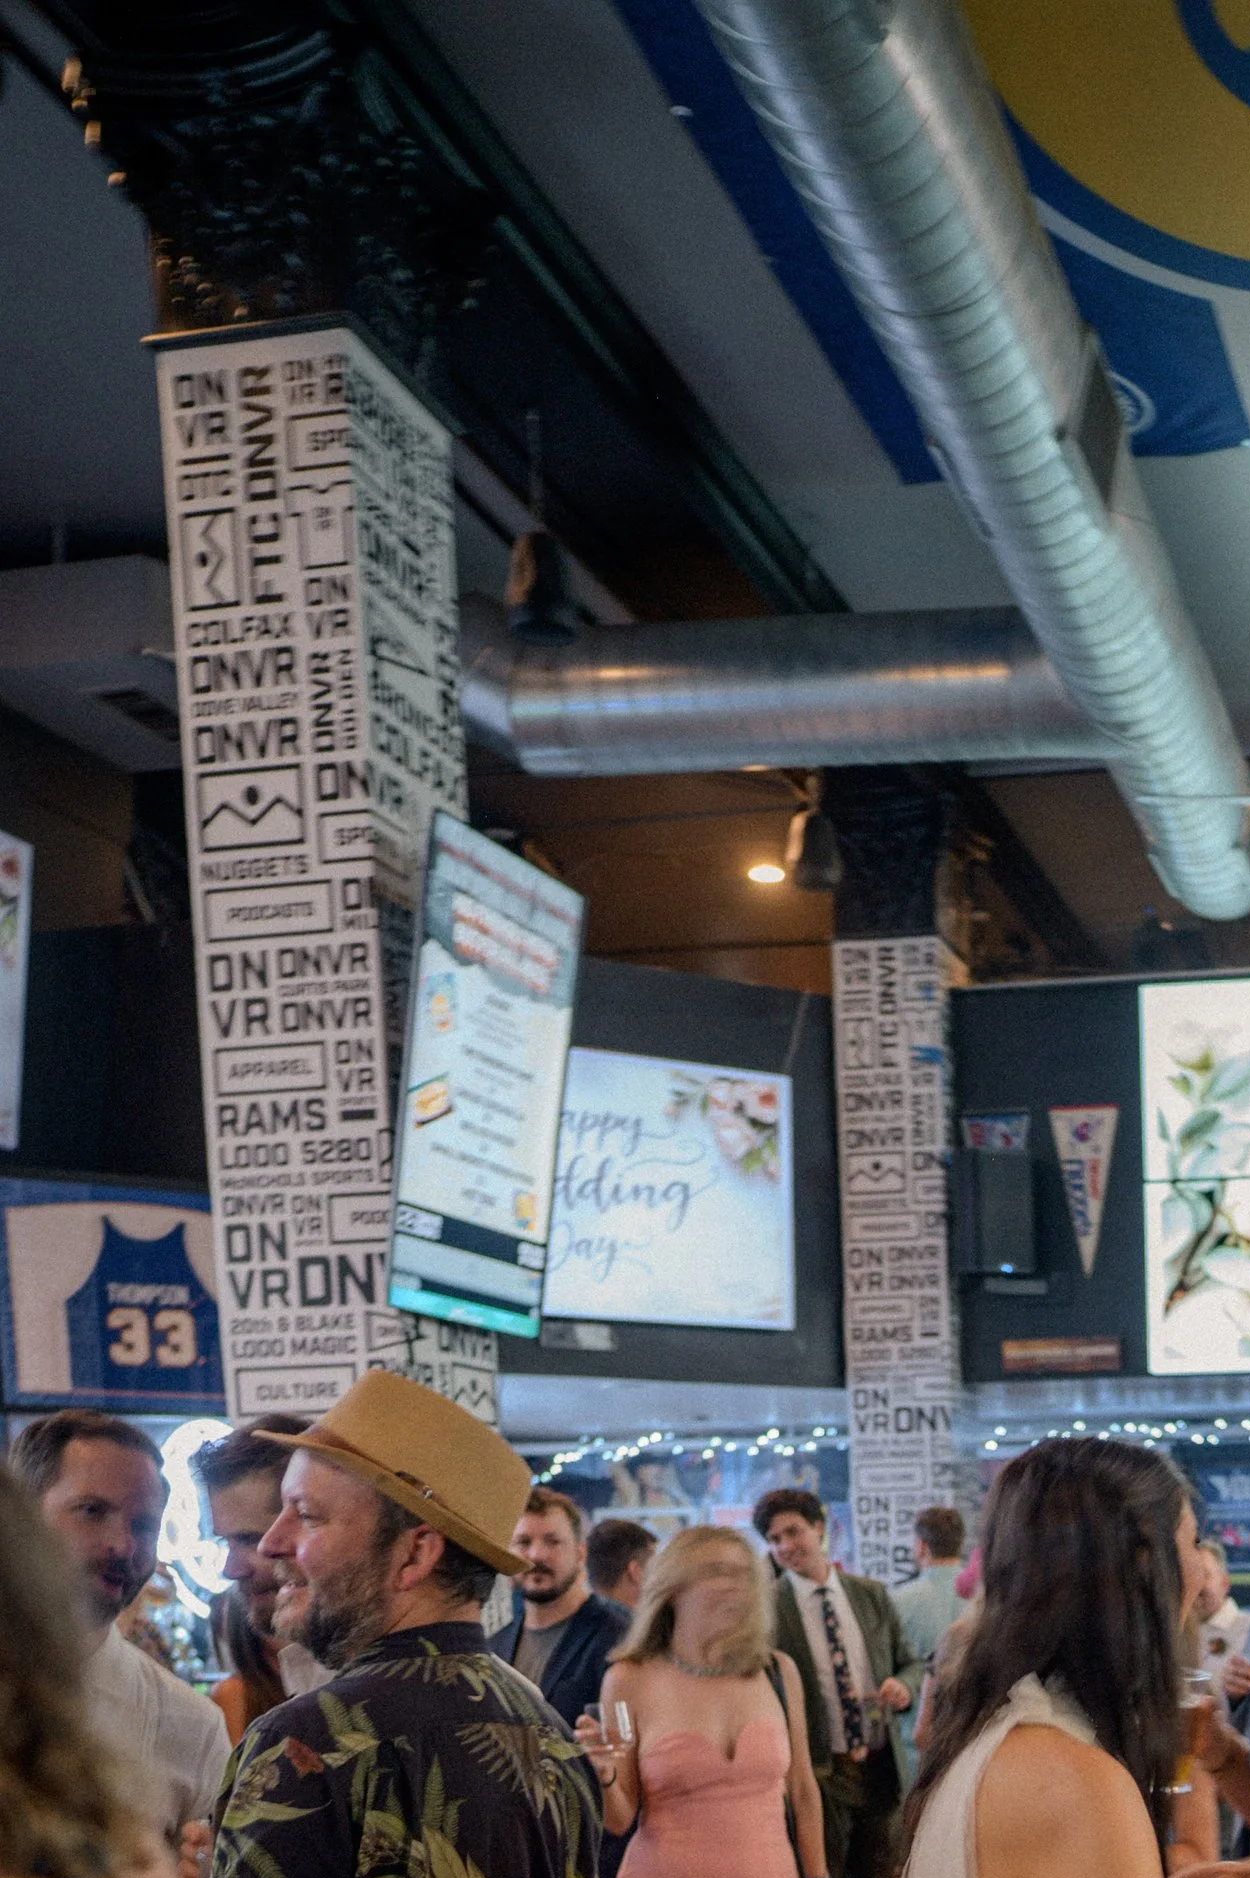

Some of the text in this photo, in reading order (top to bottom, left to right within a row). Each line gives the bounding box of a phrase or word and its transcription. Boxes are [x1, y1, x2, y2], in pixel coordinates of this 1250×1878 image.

[188, 612, 294, 648] COLFAX
[189, 645, 298, 695] DNVR
[309, 652, 336, 753] DNVR
[194, 716, 301, 765] DNVR
[202, 855, 310, 881] NUGGETS
[207, 950, 268, 994] DN
[278, 942, 369, 979] DNVR
[211, 997, 271, 1039] VR
[281, 997, 372, 1032] DNVR
[335, 1038, 375, 1064] DN
[228, 1058, 313, 1080] APPAREL
[336, 1066, 375, 1093] VR
[217, 1098, 327, 1138] RAMS
[561, 1108, 643, 1158] appy
[218, 1137, 371, 1170] LODO 5280
[312, 1168, 375, 1186] SPORTS
[554, 1152, 692, 1234] dding
[221, 1192, 286, 1218] DNVR
[225, 1222, 287, 1264] DN
[228, 1269, 290, 1309] VR
[105, 1306, 199, 1369] 33
[295, 1311, 356, 1332] BLAKE
[290, 1334, 356, 1357] MAGIC
[255, 1381, 340, 1402] CULTURE
[853, 1389, 890, 1410] DN
[854, 1413, 889, 1433] VR
